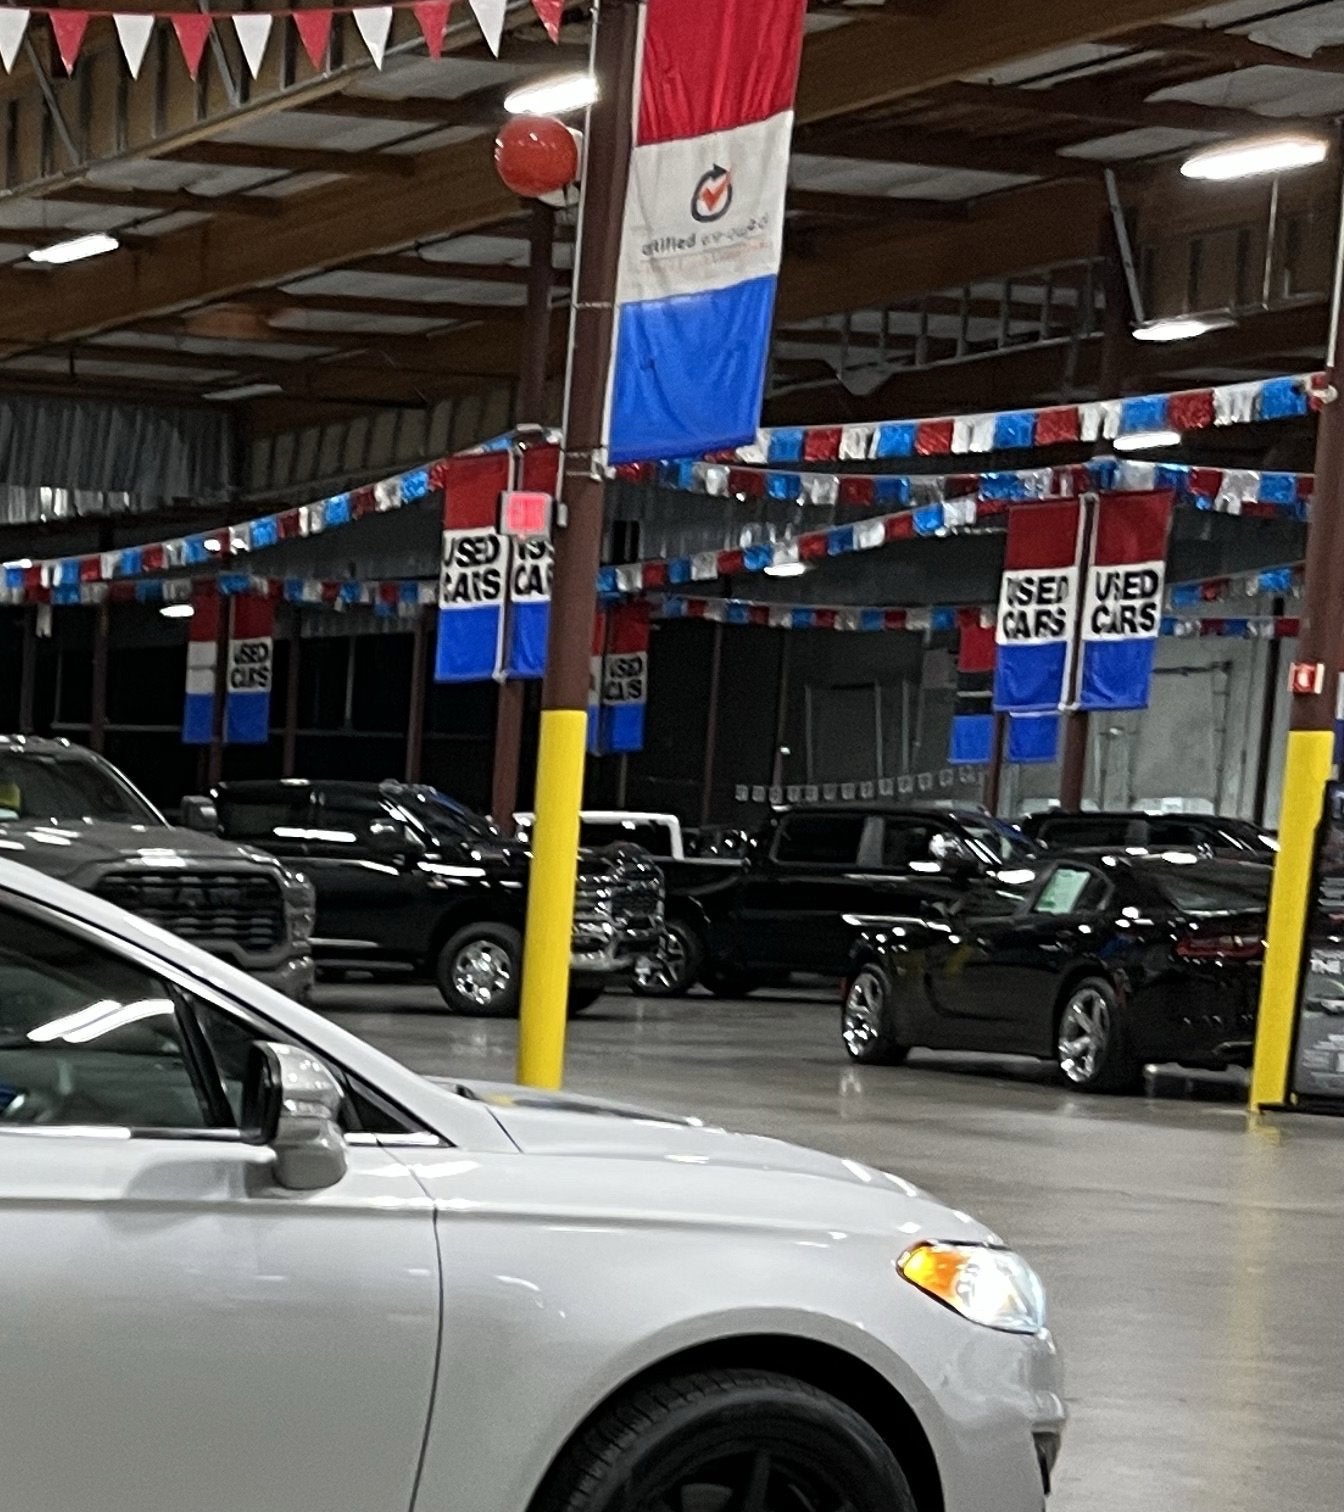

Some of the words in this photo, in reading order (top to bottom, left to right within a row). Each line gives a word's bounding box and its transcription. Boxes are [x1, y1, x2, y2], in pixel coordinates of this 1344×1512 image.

[1095, 570, 1159, 602] USED
[1003, 608, 1067, 639] CARS
[1091, 602, 1157, 634] CARS
